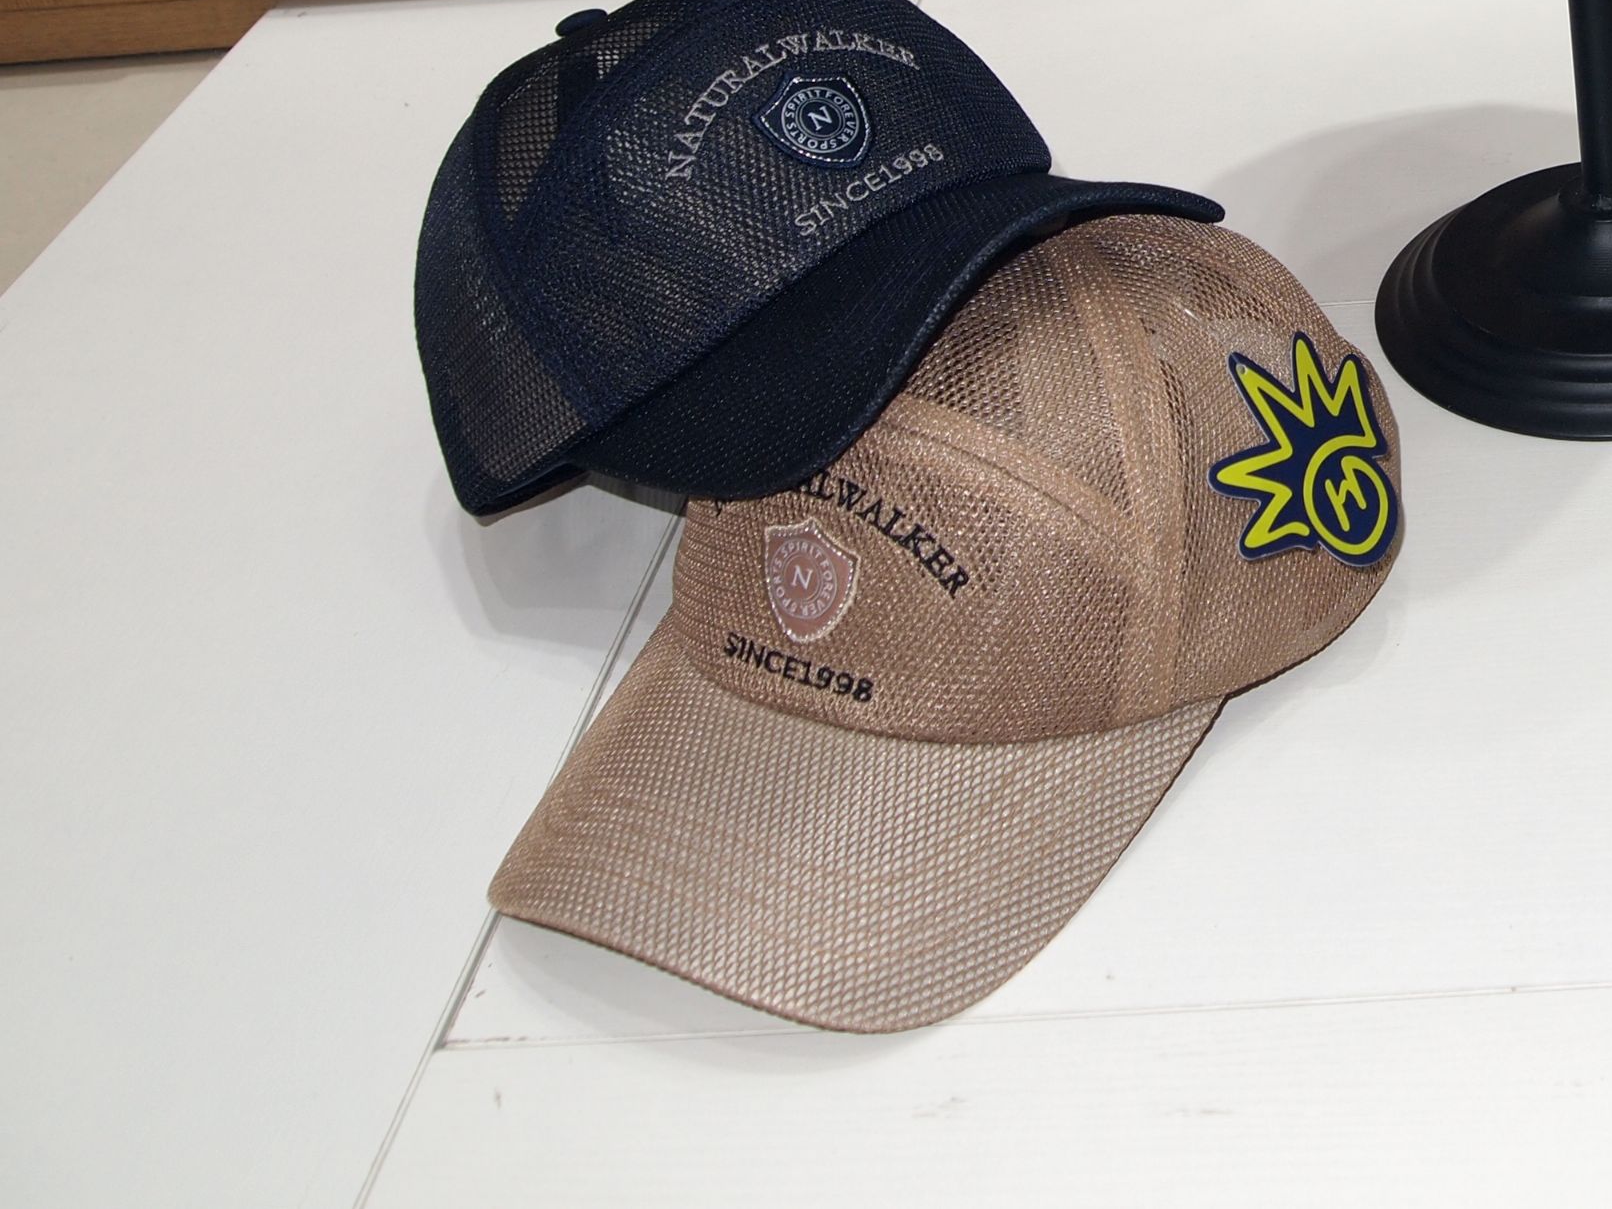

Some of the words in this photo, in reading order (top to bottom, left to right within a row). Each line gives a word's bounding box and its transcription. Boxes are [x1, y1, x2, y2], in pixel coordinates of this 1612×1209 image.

[665, 29, 920, 181] NATURALWALKER
[785, 90, 821, 118] SPIRIT
[808, 106, 832, 130] N
[826, 92, 856, 142] FOREVER
[786, 122, 837, 150] SPORTS
[794, 143, 944, 236] SINCE1998
[790, 565, 813, 590] N
[723, 631, 874, 703] SINCE1998
